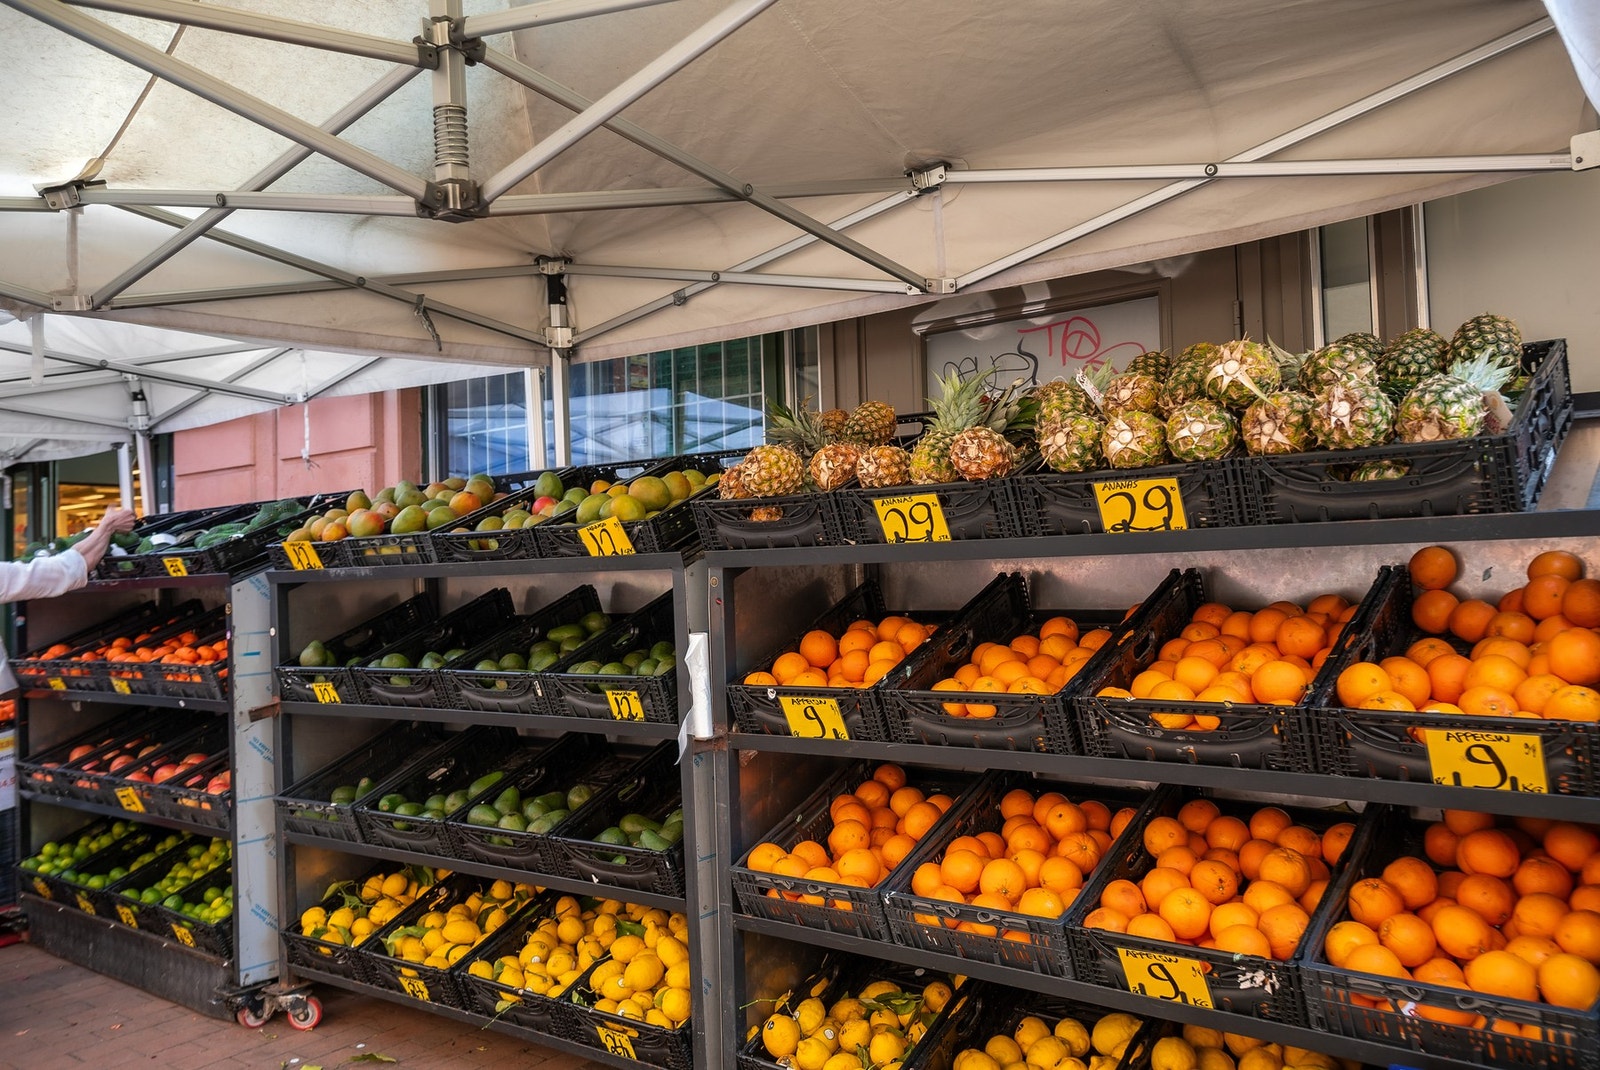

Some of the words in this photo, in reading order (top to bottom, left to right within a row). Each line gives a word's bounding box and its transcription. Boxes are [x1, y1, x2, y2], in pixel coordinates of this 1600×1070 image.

[881, 496, 914, 507] ANANAS
[1102, 481, 1138, 491] ANANAS
[883, 501, 935, 542] 29
[1104, 485, 1174, 531] 29
[803, 705, 827, 739] 9
[1465, 743, 1508, 789] 9
[1147, 962, 1180, 1001] 9
